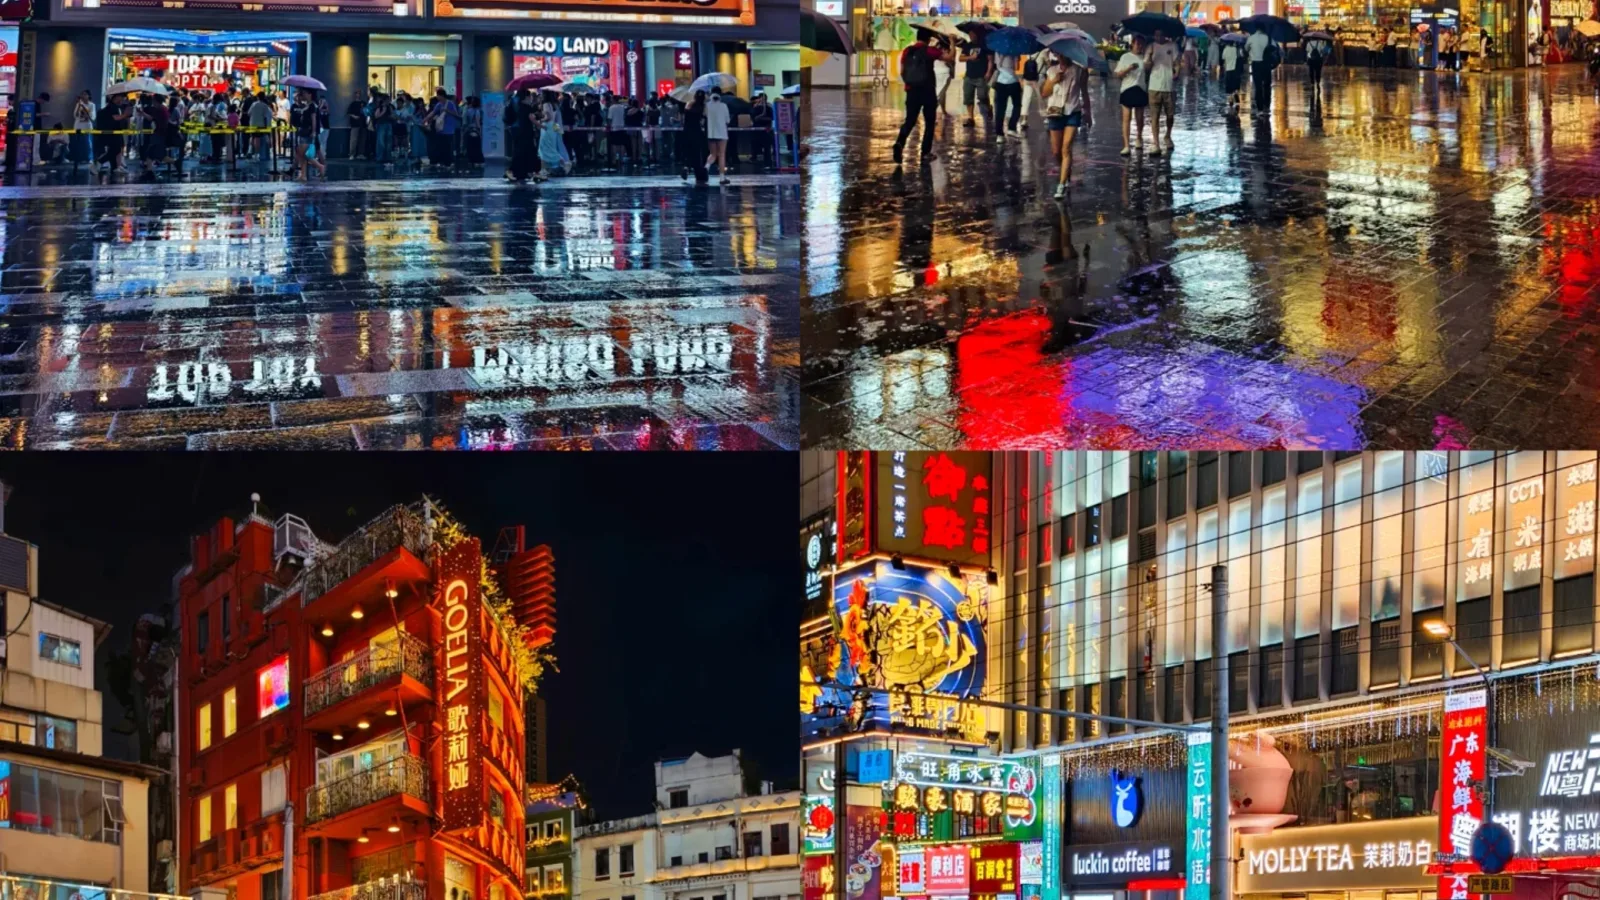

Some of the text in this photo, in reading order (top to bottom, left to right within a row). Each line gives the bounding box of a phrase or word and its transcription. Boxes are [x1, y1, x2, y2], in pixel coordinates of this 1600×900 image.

[1054, 3, 1096, 14] adidas
[563, 37, 609, 55] LAND
[166, 55, 236, 75] TOP TOY
[1467, 528, 1492, 558] 有
[1515, 515, 1542, 547] 米
[445, 579, 469, 701] GOELIA
[447, 704, 469, 791] 歌莉娅
[1449, 732, 1479, 756] 广东
[920, 761, 1004, 787] 旺角冰室
[1551, 751, 1588, 773] NEW
[1565, 813, 1599, 831] NEW
[931, 855, 965, 877] 便利店
[1073, 851, 1151, 875] luckin coffee
[1249, 840, 1432, 875] MOLLY TEA 茉莉奶白
